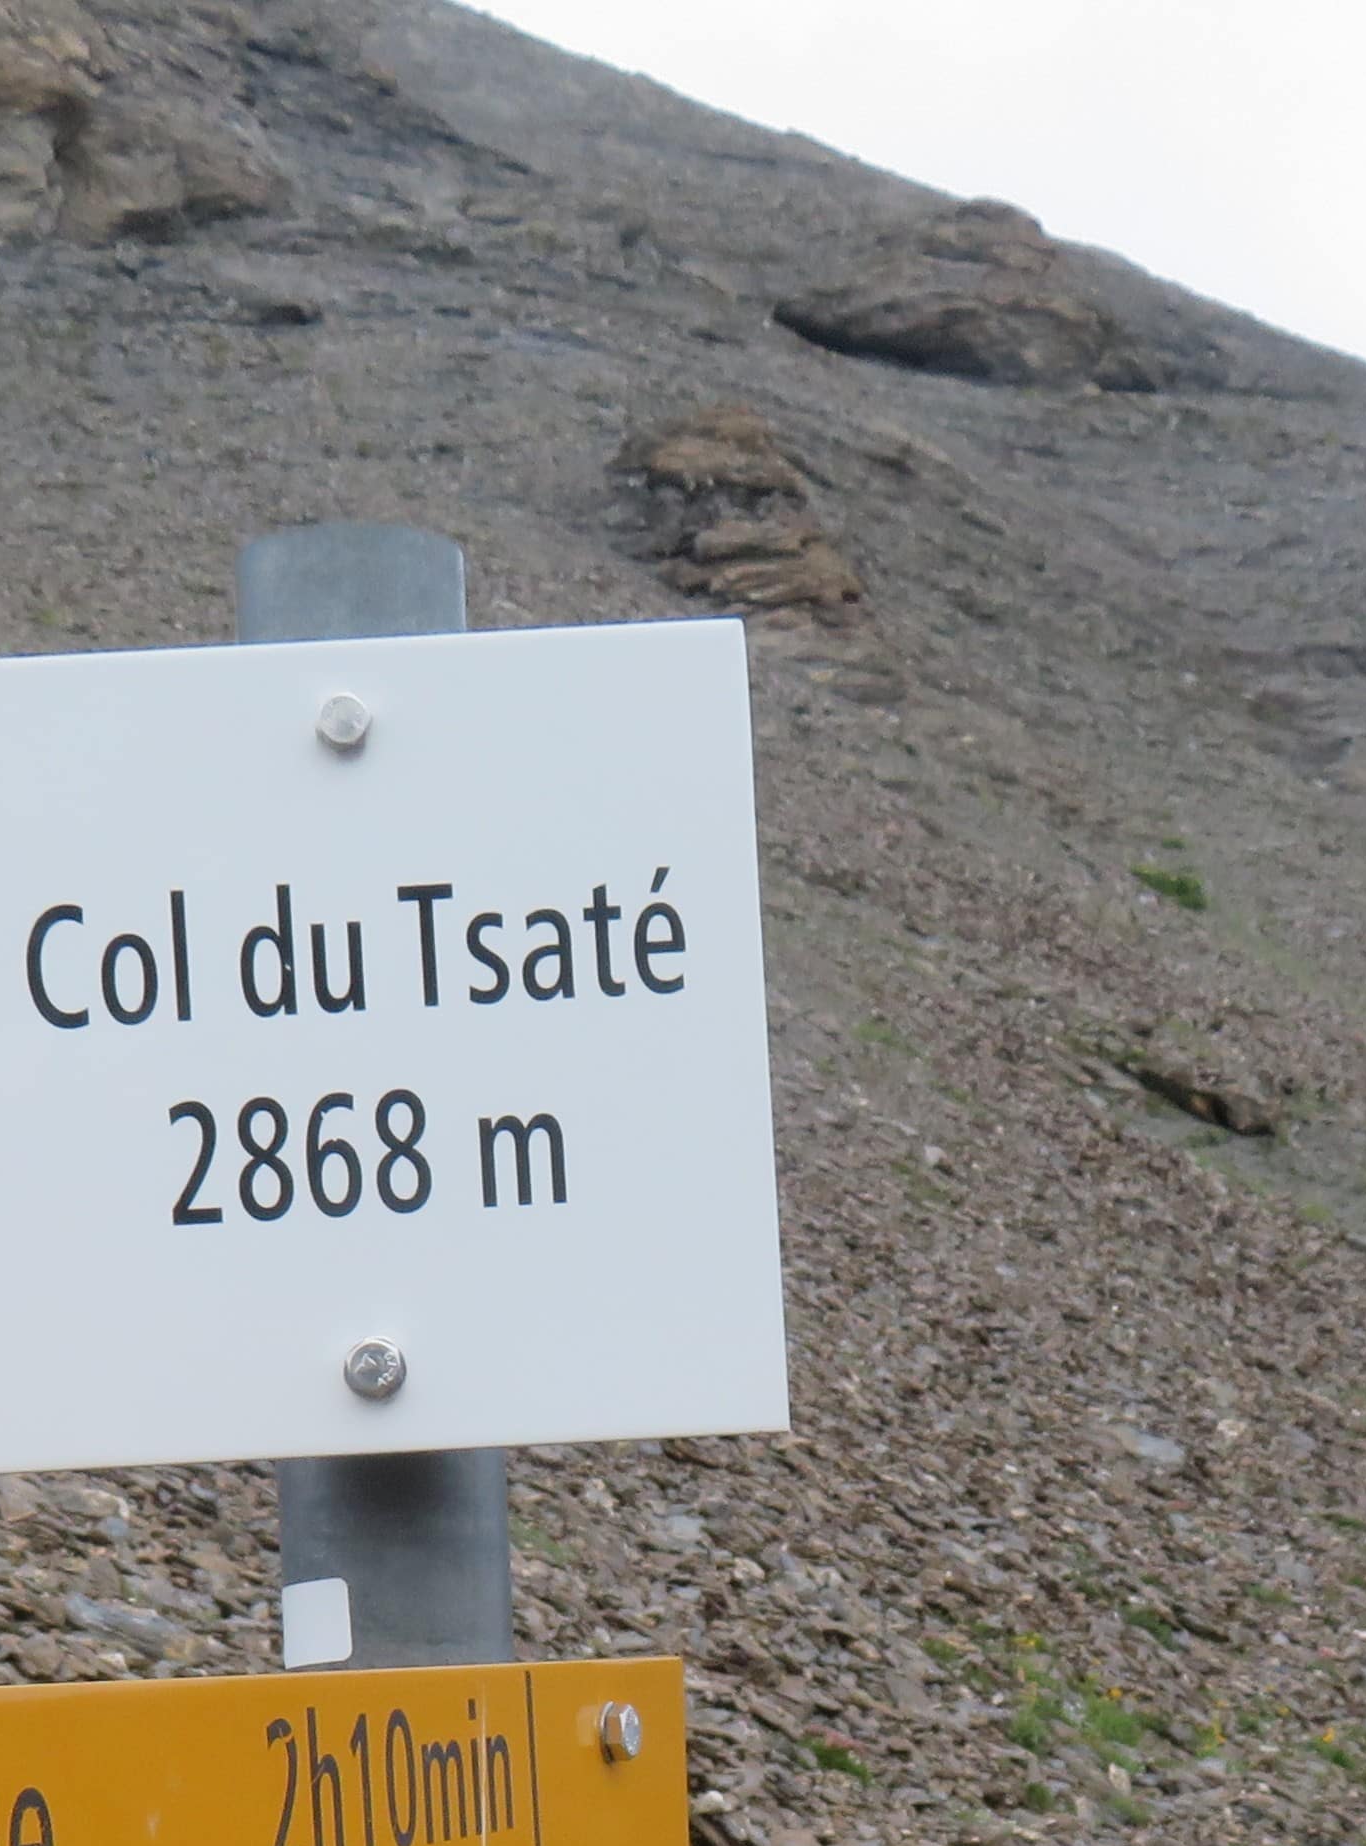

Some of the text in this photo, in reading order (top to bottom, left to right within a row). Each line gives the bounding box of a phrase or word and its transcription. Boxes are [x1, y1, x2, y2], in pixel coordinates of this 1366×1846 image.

[27, 868, 685, 1028] Col du Tsaté
[170, 1090, 566, 1224] 2868 m
